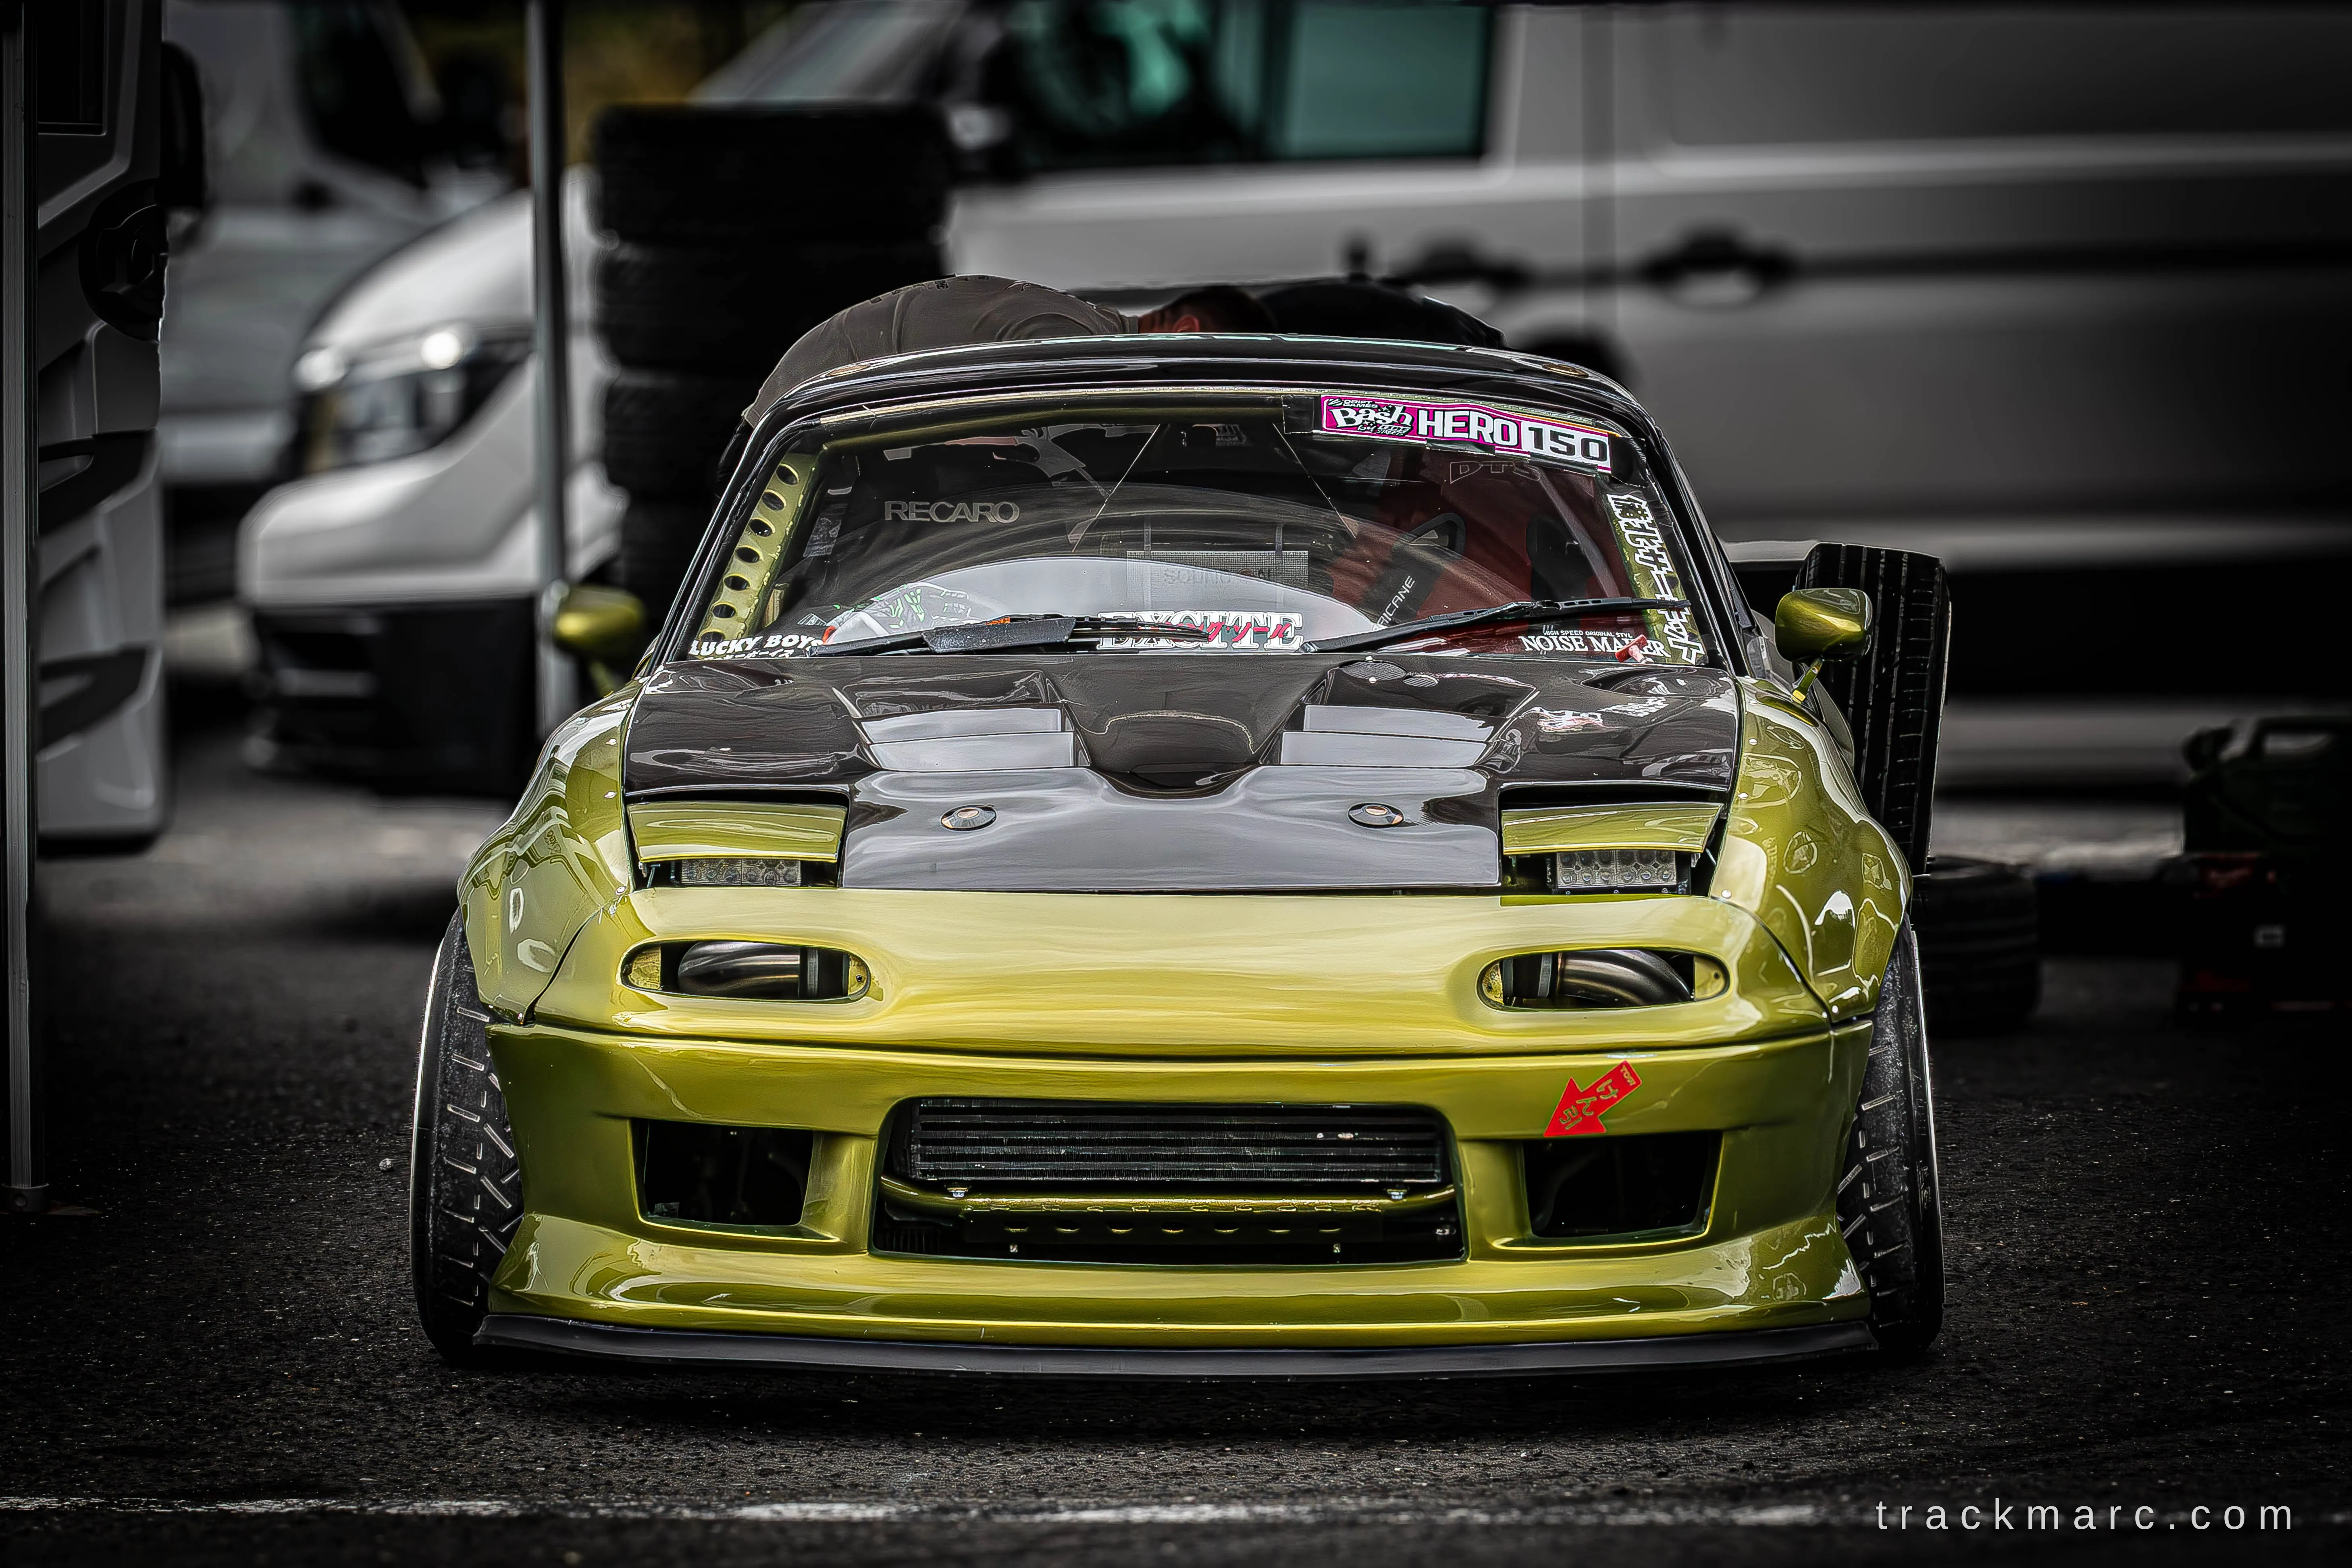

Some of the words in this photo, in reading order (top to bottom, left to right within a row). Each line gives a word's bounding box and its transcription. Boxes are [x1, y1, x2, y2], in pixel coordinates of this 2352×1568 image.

[1329, 406, 1412, 427] Bash
[1418, 410, 1519, 446] HERO
[1528, 426, 1608, 462] 150
[884, 501, 1020, 524] RECARO
[688, 635, 763, 656] LUCKY
[1518, 635, 1589, 652] NOISE
[1620, 1064, 1636, 1086] TOW
[1559, 1079, 1618, 1130] けん引
